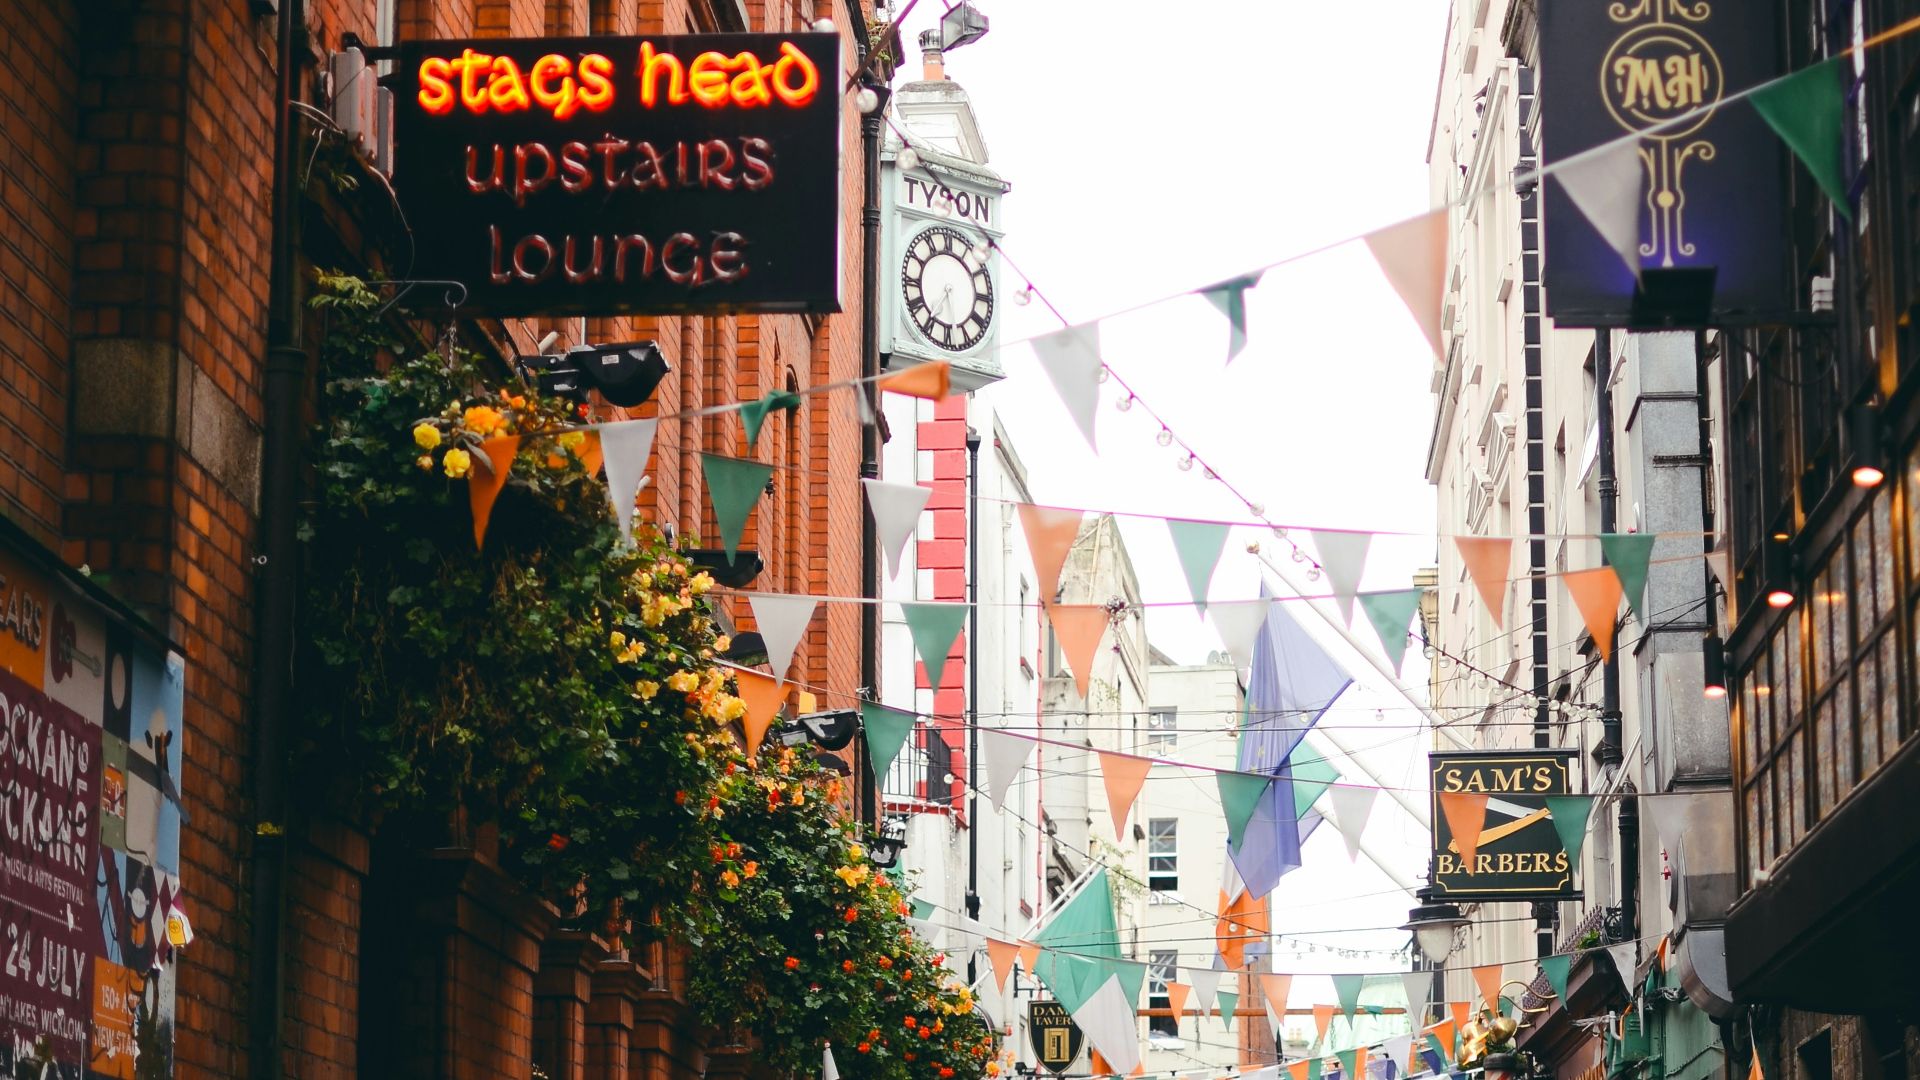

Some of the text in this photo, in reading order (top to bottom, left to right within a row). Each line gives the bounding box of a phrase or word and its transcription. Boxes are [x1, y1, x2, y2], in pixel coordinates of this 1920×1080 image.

[1444, 765, 1552, 793] SAM'S
[0, 779, 71, 867] CKAN
[5, 855, 27, 881] MUSIC
[27, 865, 33, 884] &
[34, 868, 53, 892] ARTS
[53, 876, 85, 906] FESTIVAL
[1437, 852, 1569, 875] BARBERS
[6, 922, 86, 1000] 24 JULY
[1035, 1016, 1074, 1026] TAVER
